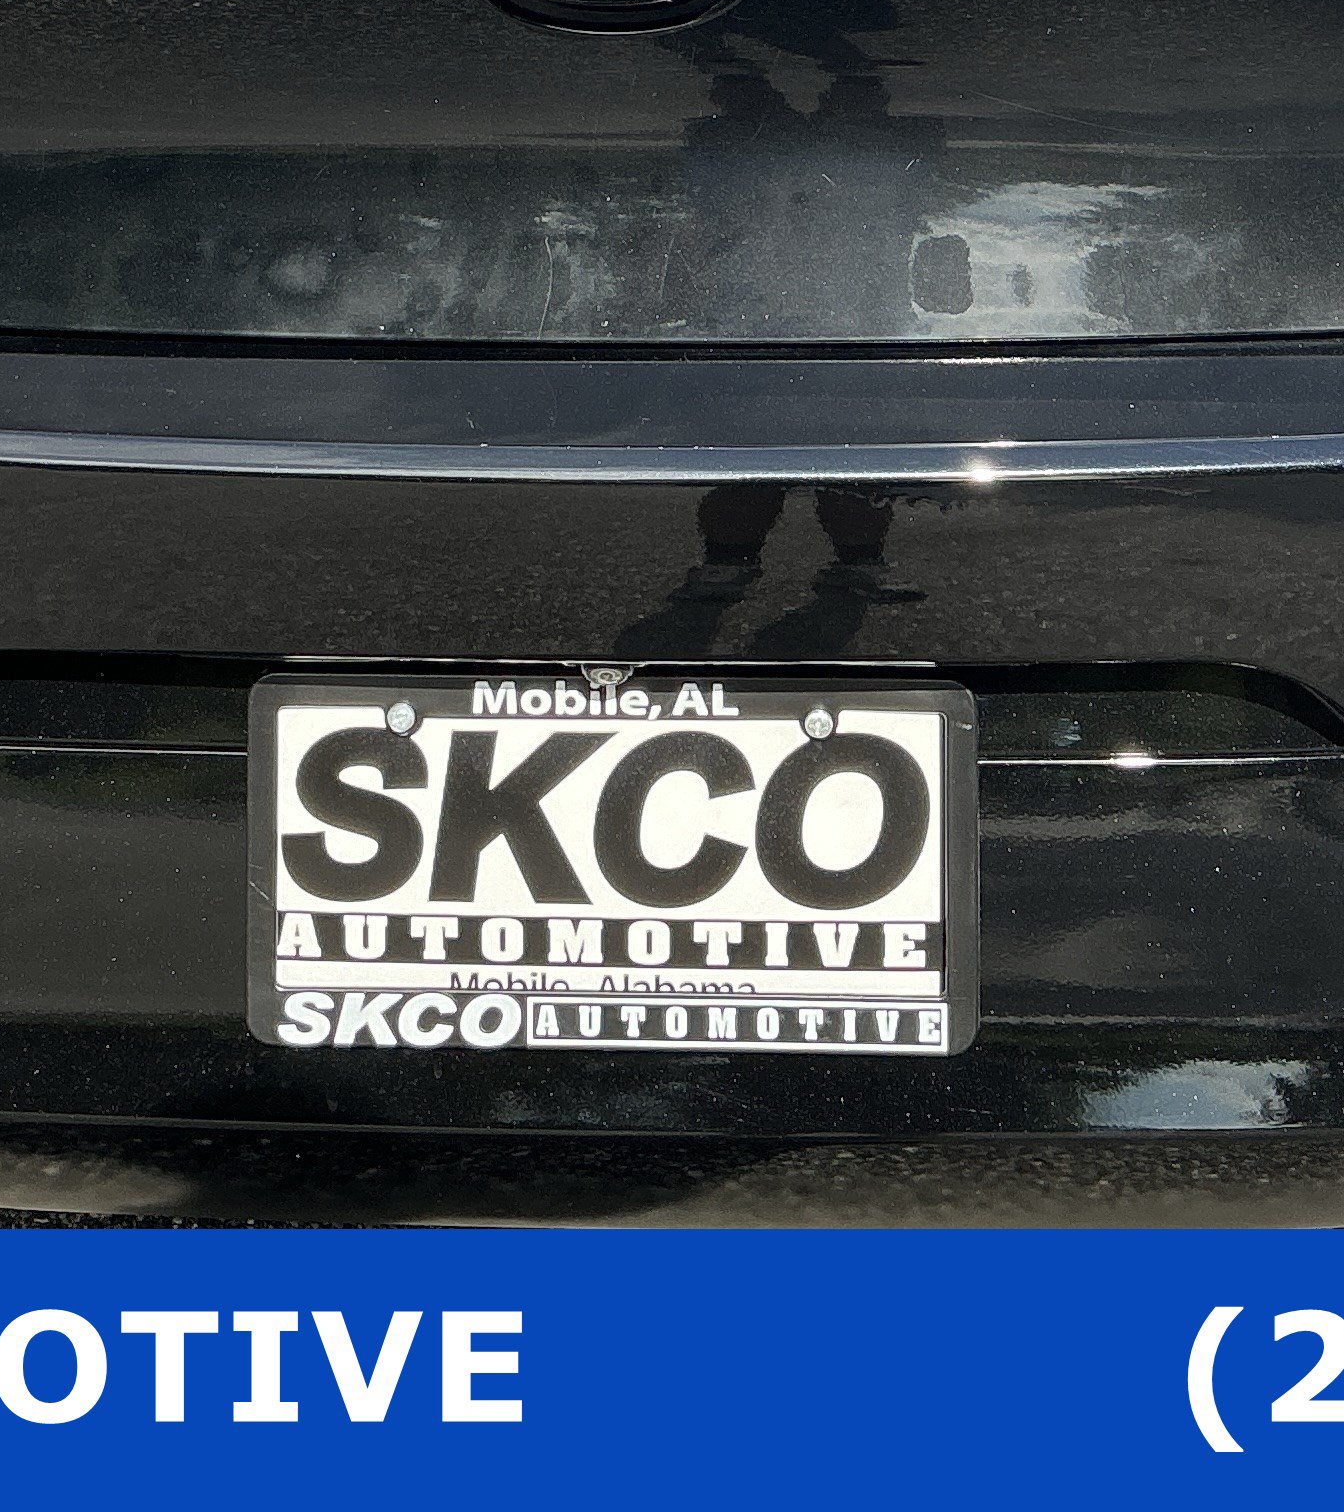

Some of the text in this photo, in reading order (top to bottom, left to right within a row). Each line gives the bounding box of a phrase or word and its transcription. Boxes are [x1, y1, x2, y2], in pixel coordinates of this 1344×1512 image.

[472, 680, 740, 720] Mobile, AL
[280, 725, 932, 911] SKCO
[276, 913, 928, 969] AUTOMOTIVE
[276, 991, 944, 1048] SKCO AUTOMOTIVE
